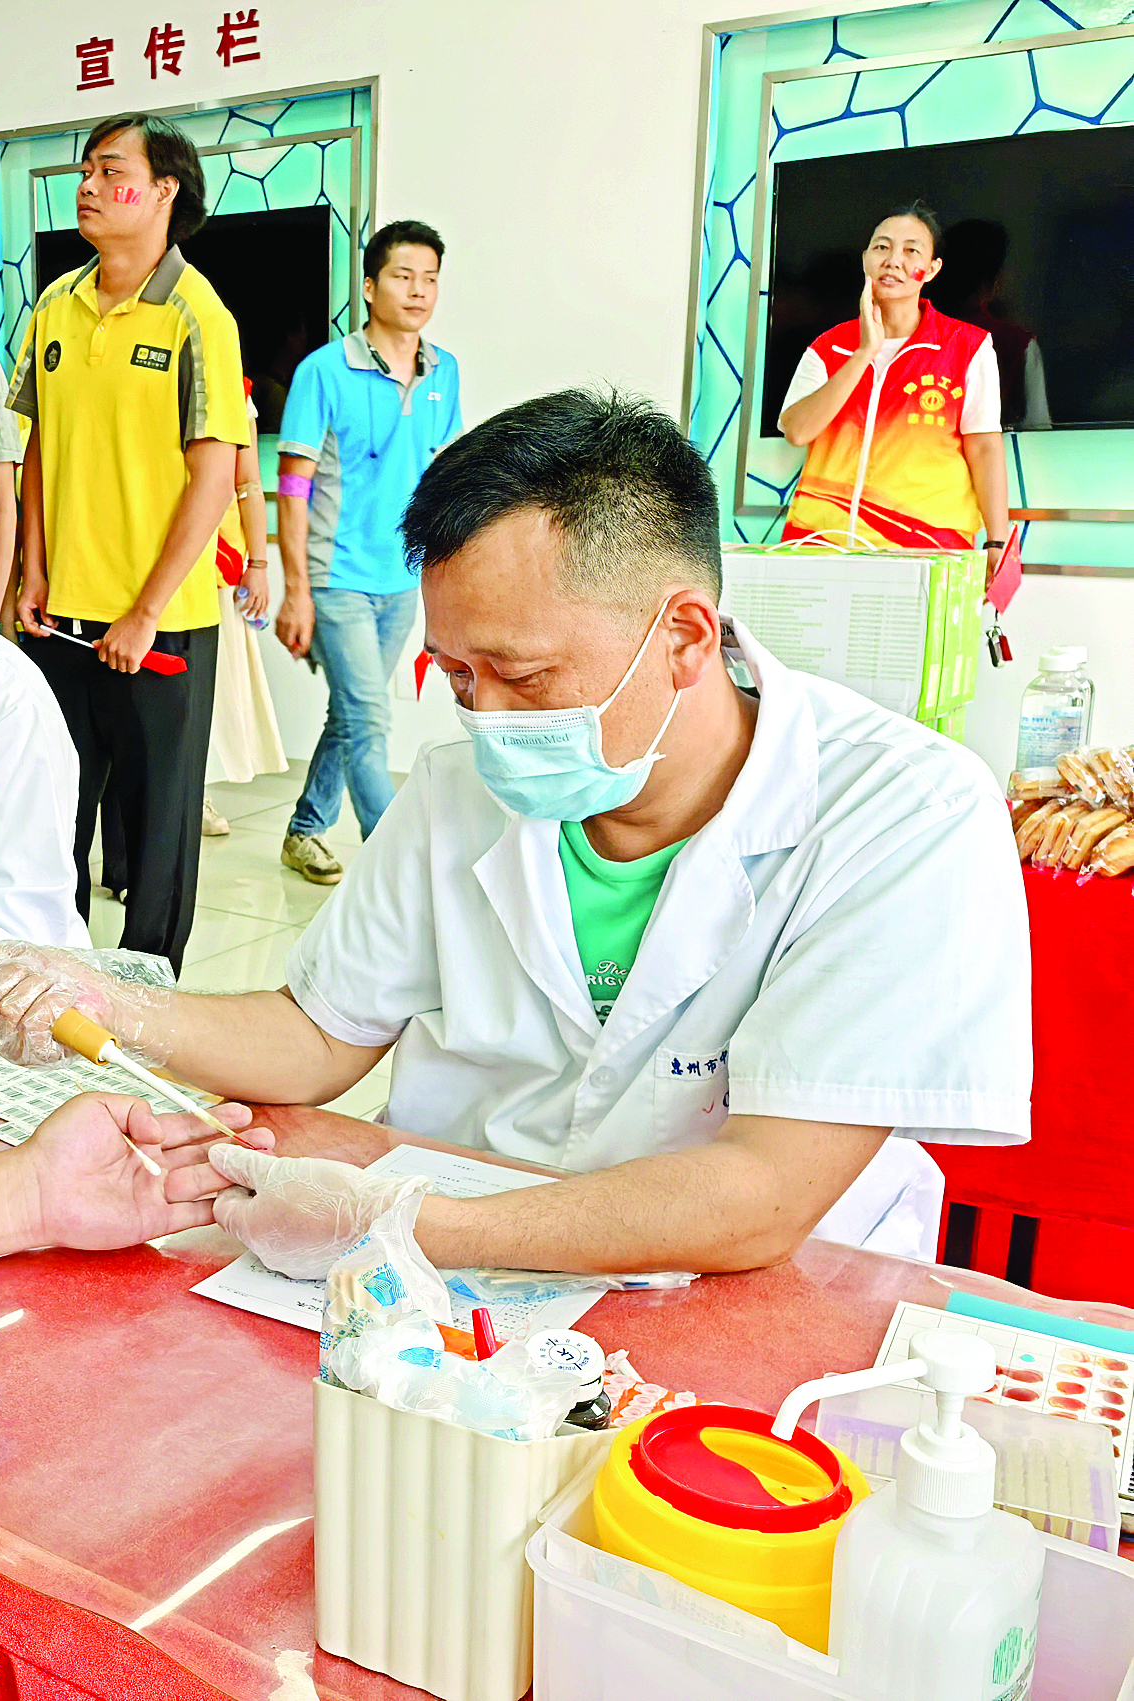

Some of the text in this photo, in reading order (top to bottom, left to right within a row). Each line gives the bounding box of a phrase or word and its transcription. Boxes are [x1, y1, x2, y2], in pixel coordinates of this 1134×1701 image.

[76, 8, 261, 91] 宣传栏
[596, 960, 628, 975] The
